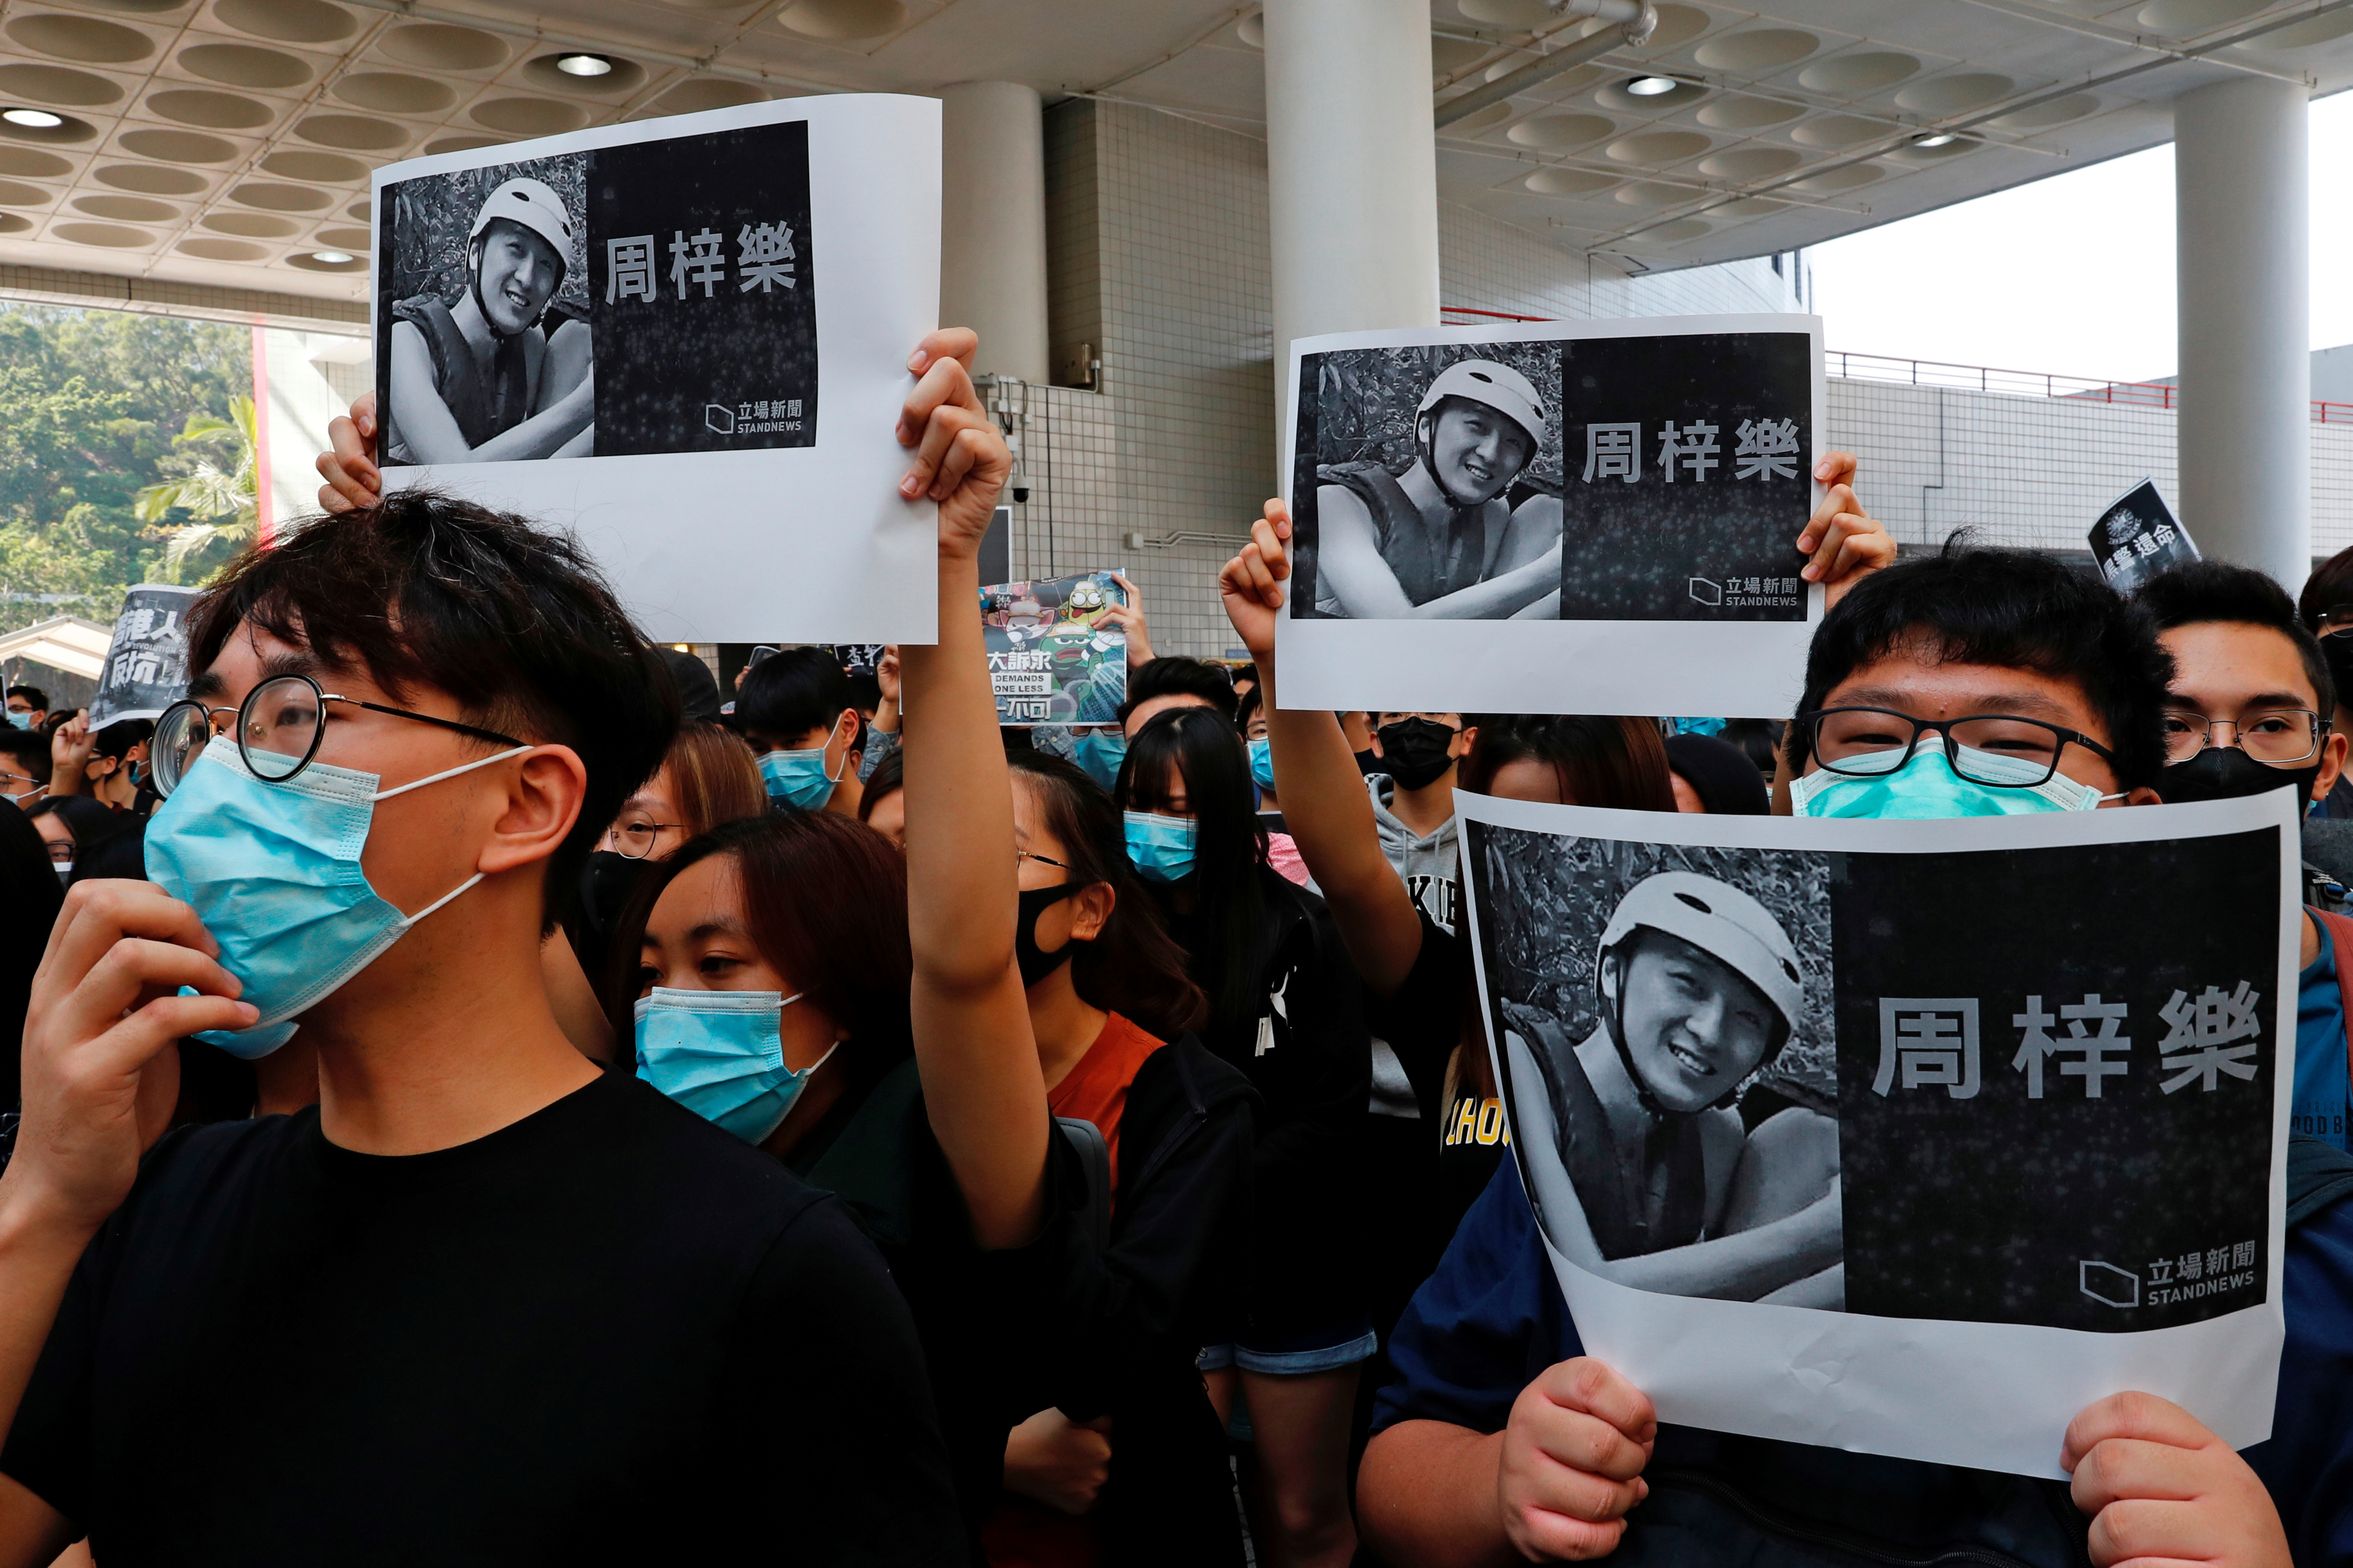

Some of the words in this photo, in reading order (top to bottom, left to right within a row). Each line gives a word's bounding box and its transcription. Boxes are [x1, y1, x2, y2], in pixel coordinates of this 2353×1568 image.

[605, 220, 796, 306] 周梓樂
[738, 400, 802, 420] 立場新聞
[738, 421, 802, 434] STANDNEWS
[1581, 418, 1800, 484] 周梓樂
[1726, 576, 1797, 594] 立場新聞
[1726, 597, 1797, 606] STANDNEWS
[1872, 980, 2261, 1099] 周梓樂
[2147, 1240, 2255, 1286] 立場新聞
[2148, 1271, 2254, 1306] STANDNEWS
